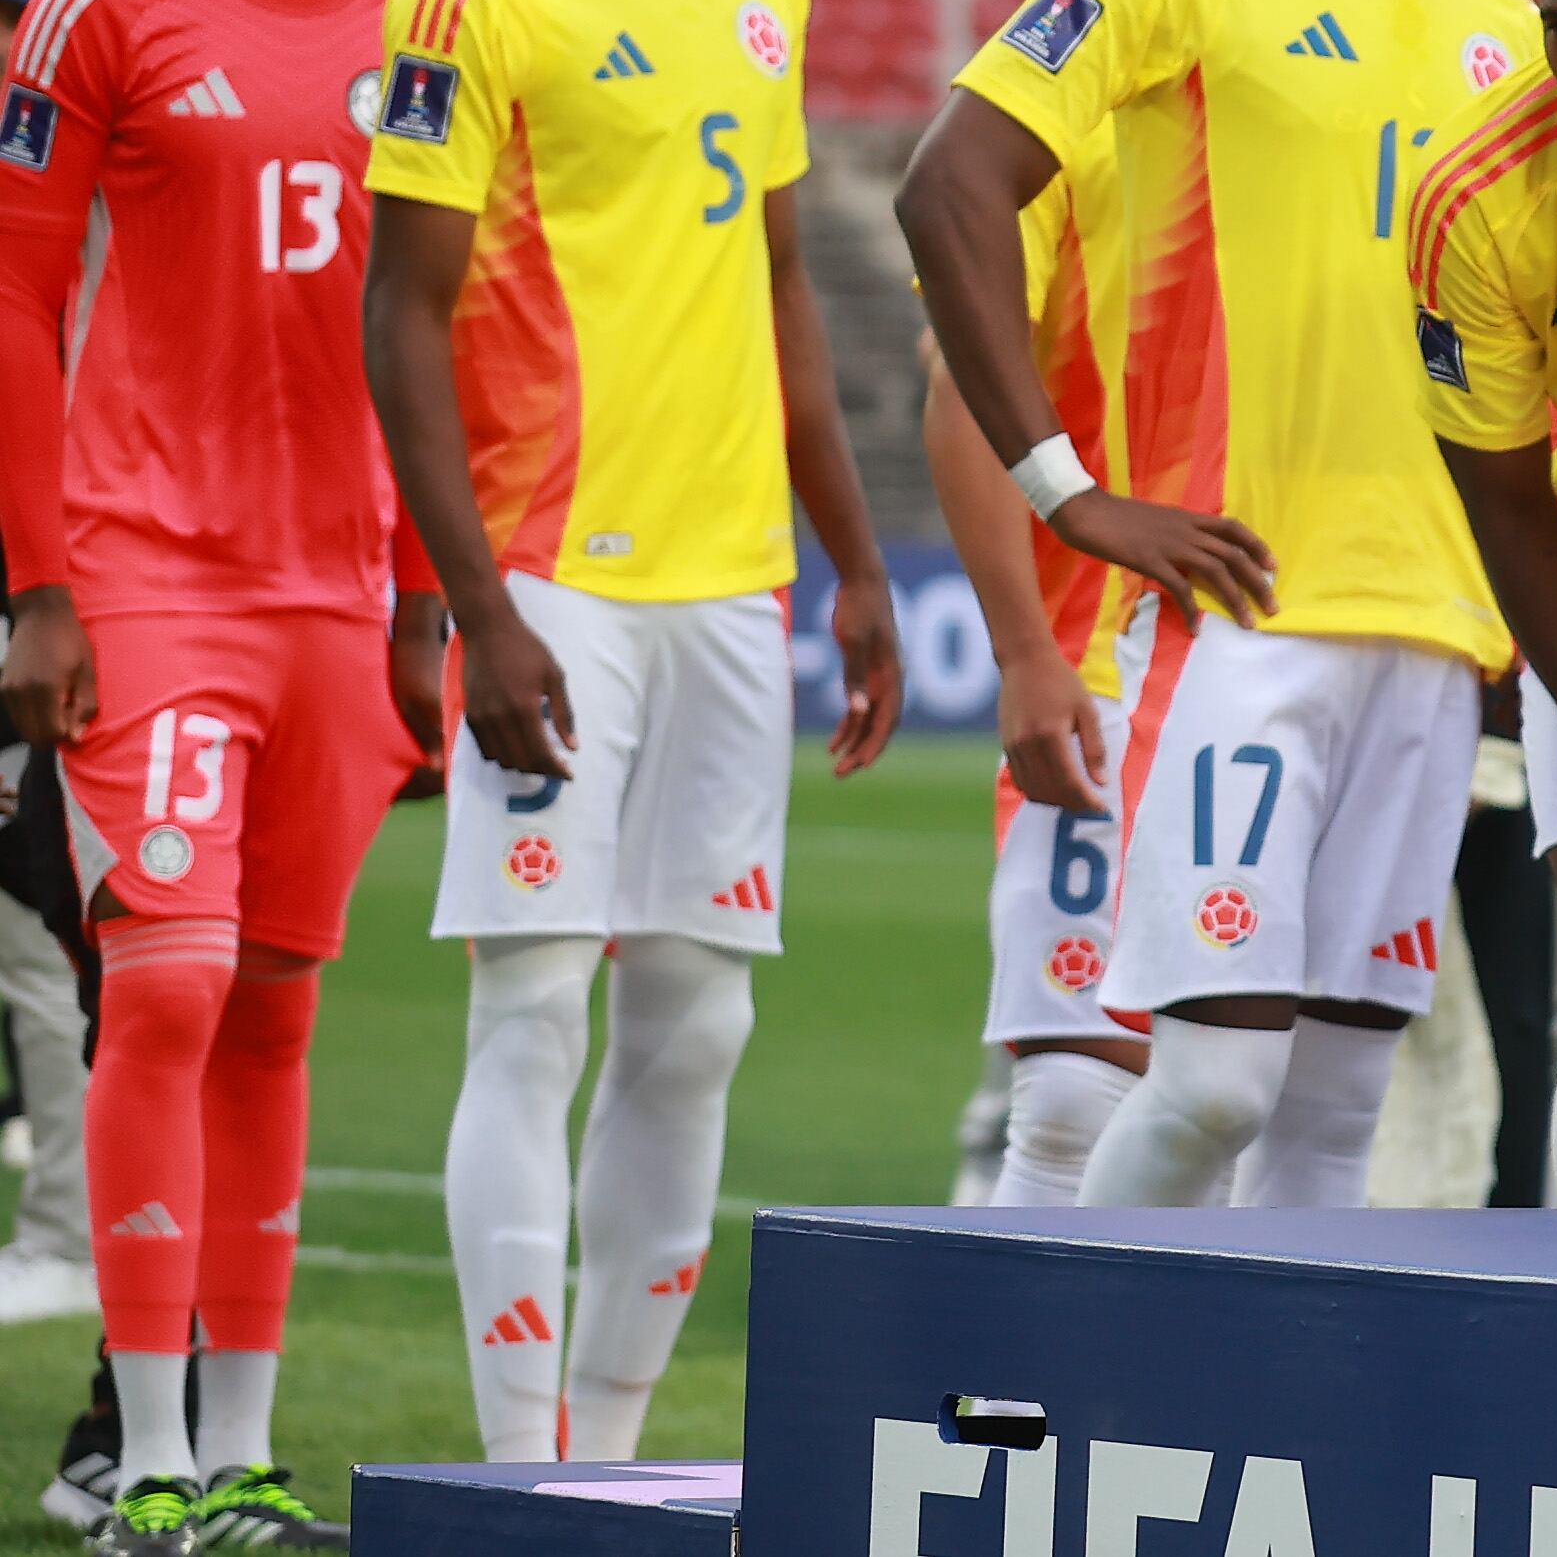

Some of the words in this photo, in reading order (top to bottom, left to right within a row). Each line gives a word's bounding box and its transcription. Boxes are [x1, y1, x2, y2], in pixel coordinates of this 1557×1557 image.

[260, 160, 342, 271] 13
[700, 113, 745, 224] 5
[144, 708, 231, 823] 13
[1193, 745, 1283, 866] 17
[1050, 809, 1113, 916] 6
